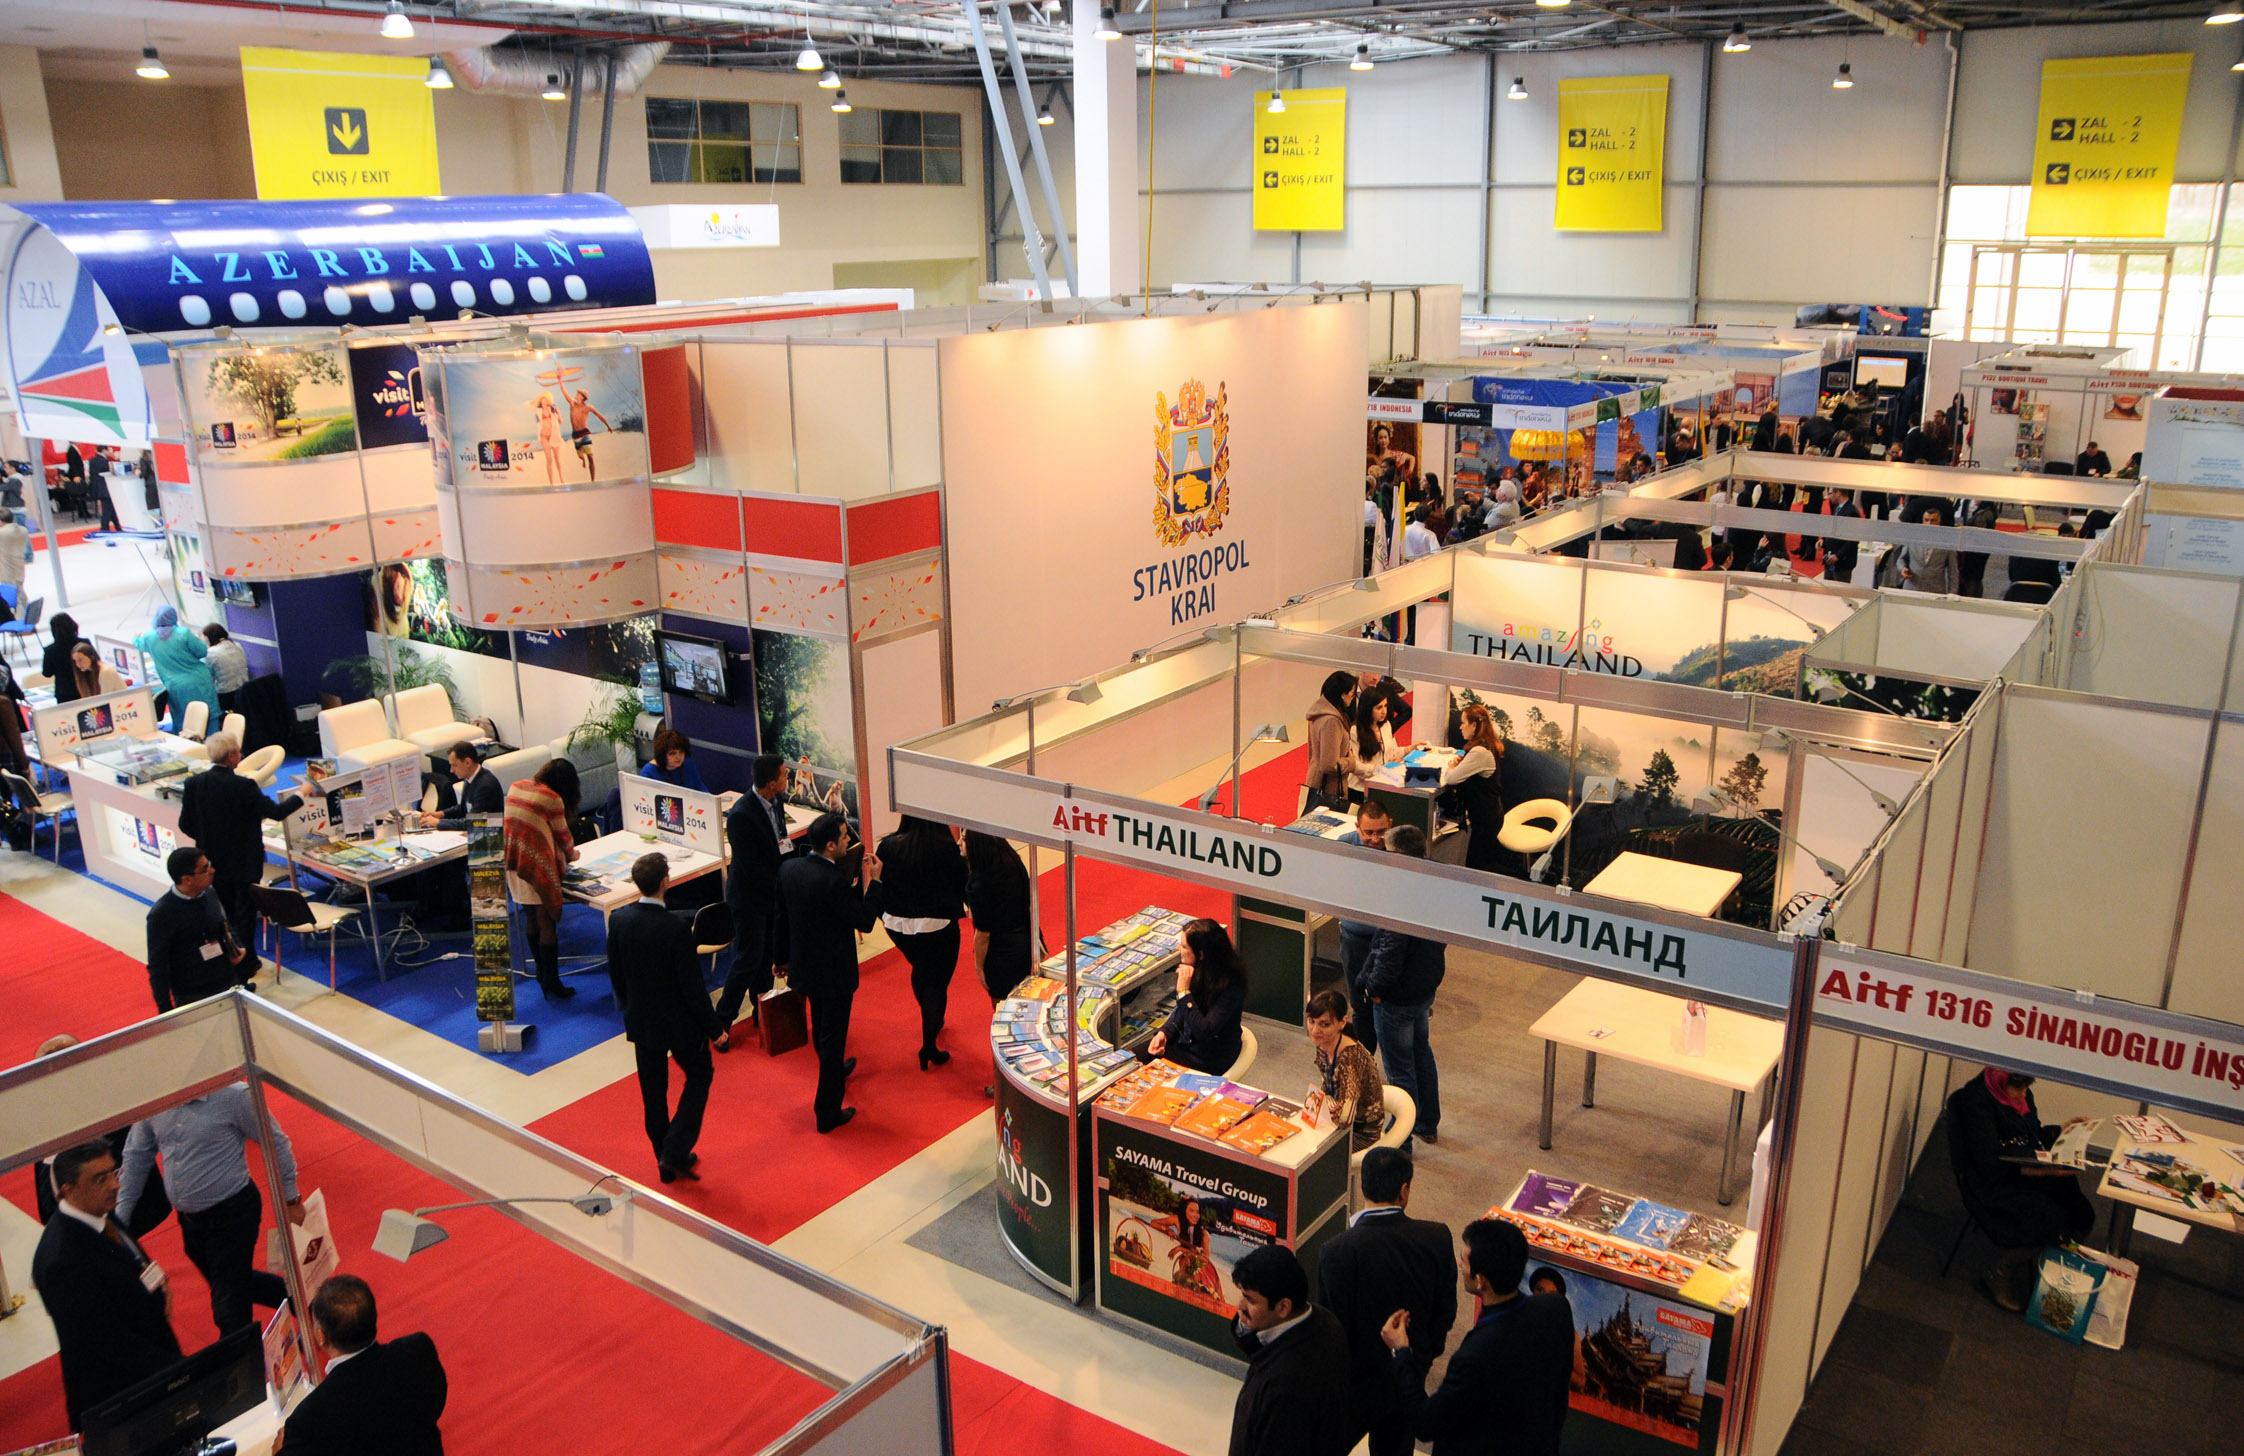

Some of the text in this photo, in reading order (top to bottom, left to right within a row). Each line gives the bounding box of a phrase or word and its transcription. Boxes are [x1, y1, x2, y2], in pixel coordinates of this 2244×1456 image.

[2081, 117, 2108, 129] ZAL
[2132, 115, 2142, 128] 2
[1282, 136, 1300, 145] ZAL
[1314, 135, 1320, 144] 2
[1590, 128, 1611, 138] ZAL
[1629, 127, 1636, 137] 2
[2080, 132, 2115, 144] HALL
[2130, 131, 2139, 143] 2
[1282, 147, 1305, 156] HALL
[1314, 147, 1320, 156] 2
[1590, 140, 1618, 150] HALL
[1628, 140, 1636, 150] 2
[312, 169, 391, 186] ÇIXIŞ / EXIT
[1281, 175, 1305, 186] ÇIXIŞ
[1314, 174, 1334, 184] EXIT
[1589, 171, 1617, 183] ÇIXIŞ
[1627, 170, 1652, 180] EXIT
[2075, 167, 2159, 182] ÇIXIŞ / EXIT
[168, 240, 576, 286] AZERBAIJAN
[18, 280, 62, 308] AZAL
[372, 386, 410, 405] visit
[1380, 405, 1413, 414] INDONESIA
[459, 451, 478, 463] visit
[511, 452, 535, 461] 2014
[1133, 540, 1250, 602] STAVROPOL
[1171, 583, 1216, 626] KRAI
[1503, 622, 1613, 655] amazing
[1468, 633, 1643, 677] THAILAND
[51, 710, 139, 739] visit MALAYSIA 2014
[299, 808, 326, 823] visit
[633, 803, 707, 834] visit MALAYSIA 2014
[1052, 805, 1283, 878] Aitf THAILAND
[1481, 895, 1687, 979] ТАИЛАНД
[1818, 969, 1914, 1013] Aitf
[1924, 989, 1993, 1029] 1316
[1115, 1145, 1268, 1209] SAYAMA Travel Group
[1660, 1311, 1693, 1331] SAYAMA
